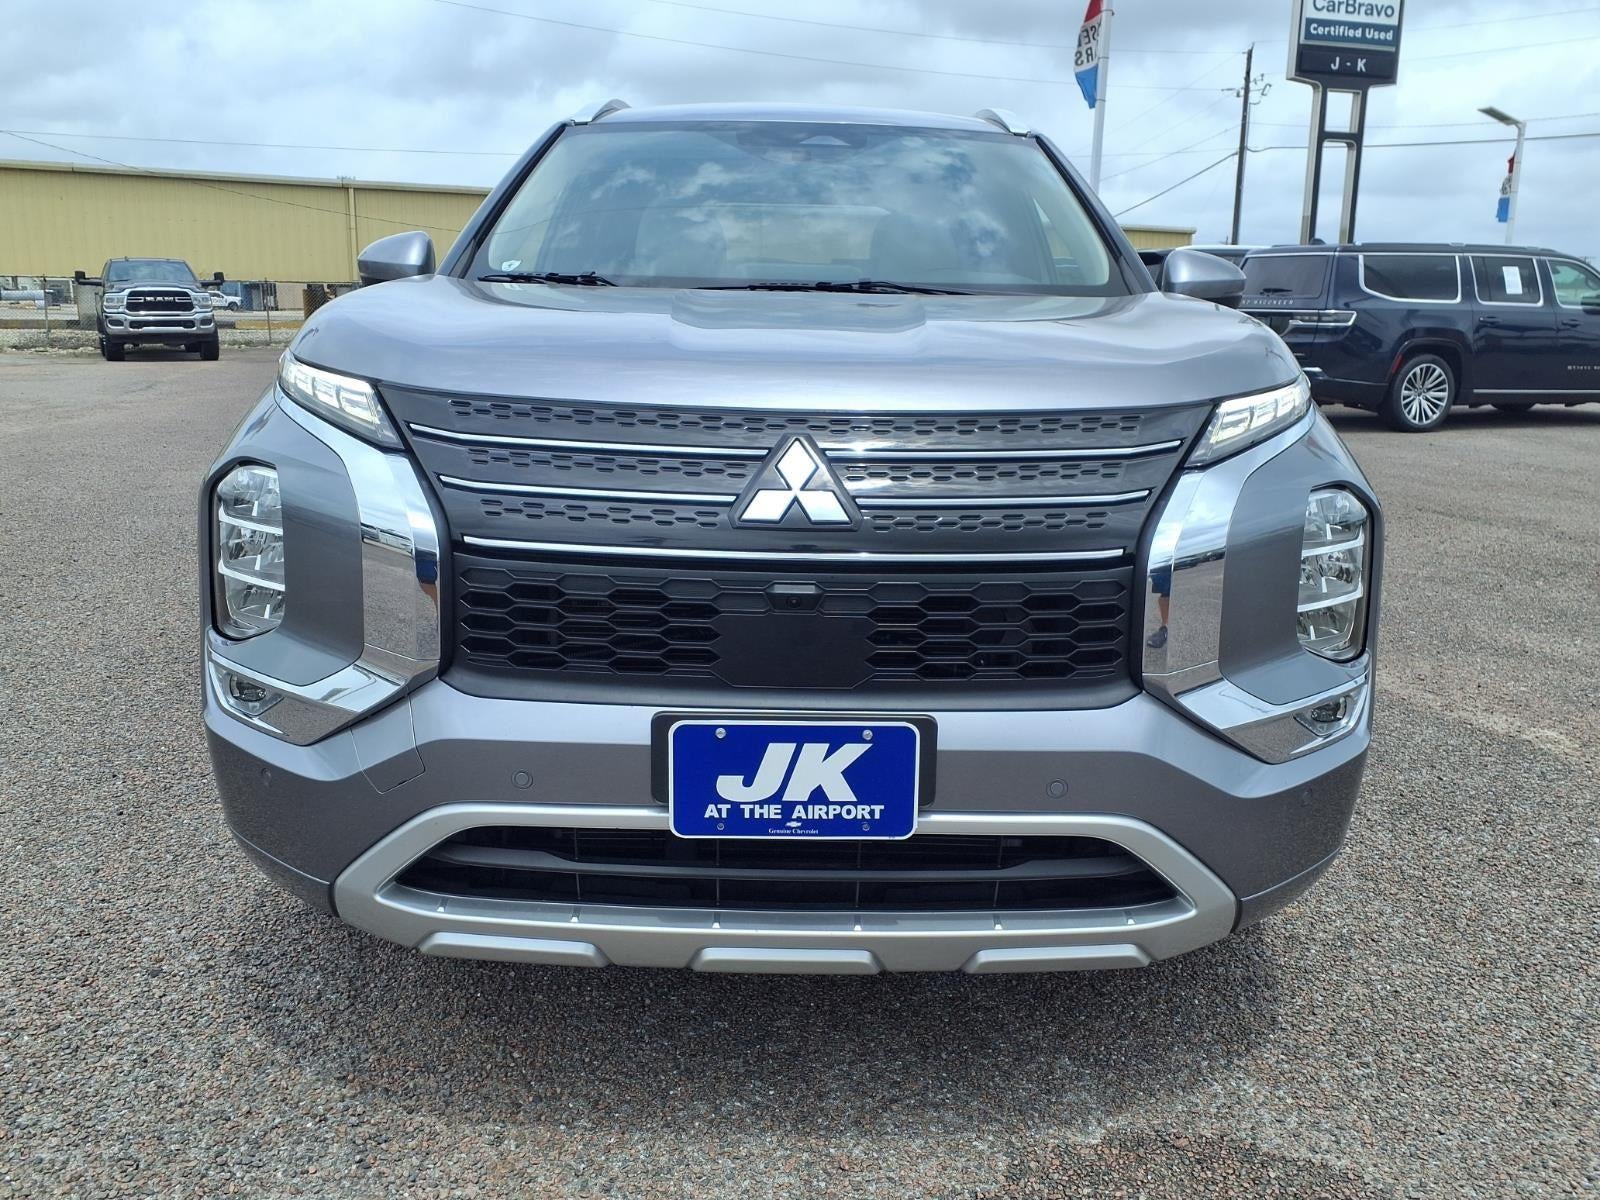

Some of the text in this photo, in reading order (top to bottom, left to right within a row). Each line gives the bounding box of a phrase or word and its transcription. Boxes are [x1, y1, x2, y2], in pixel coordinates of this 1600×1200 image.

[1312, 0, 1395, 18] CarBravo
[1310, 23, 1394, 41] Certified Used
[715, 742, 874, 803] JK
[703, 803, 885, 820] AT THE AIRPORT
[792, 827, 819, 836] Chevrolet
